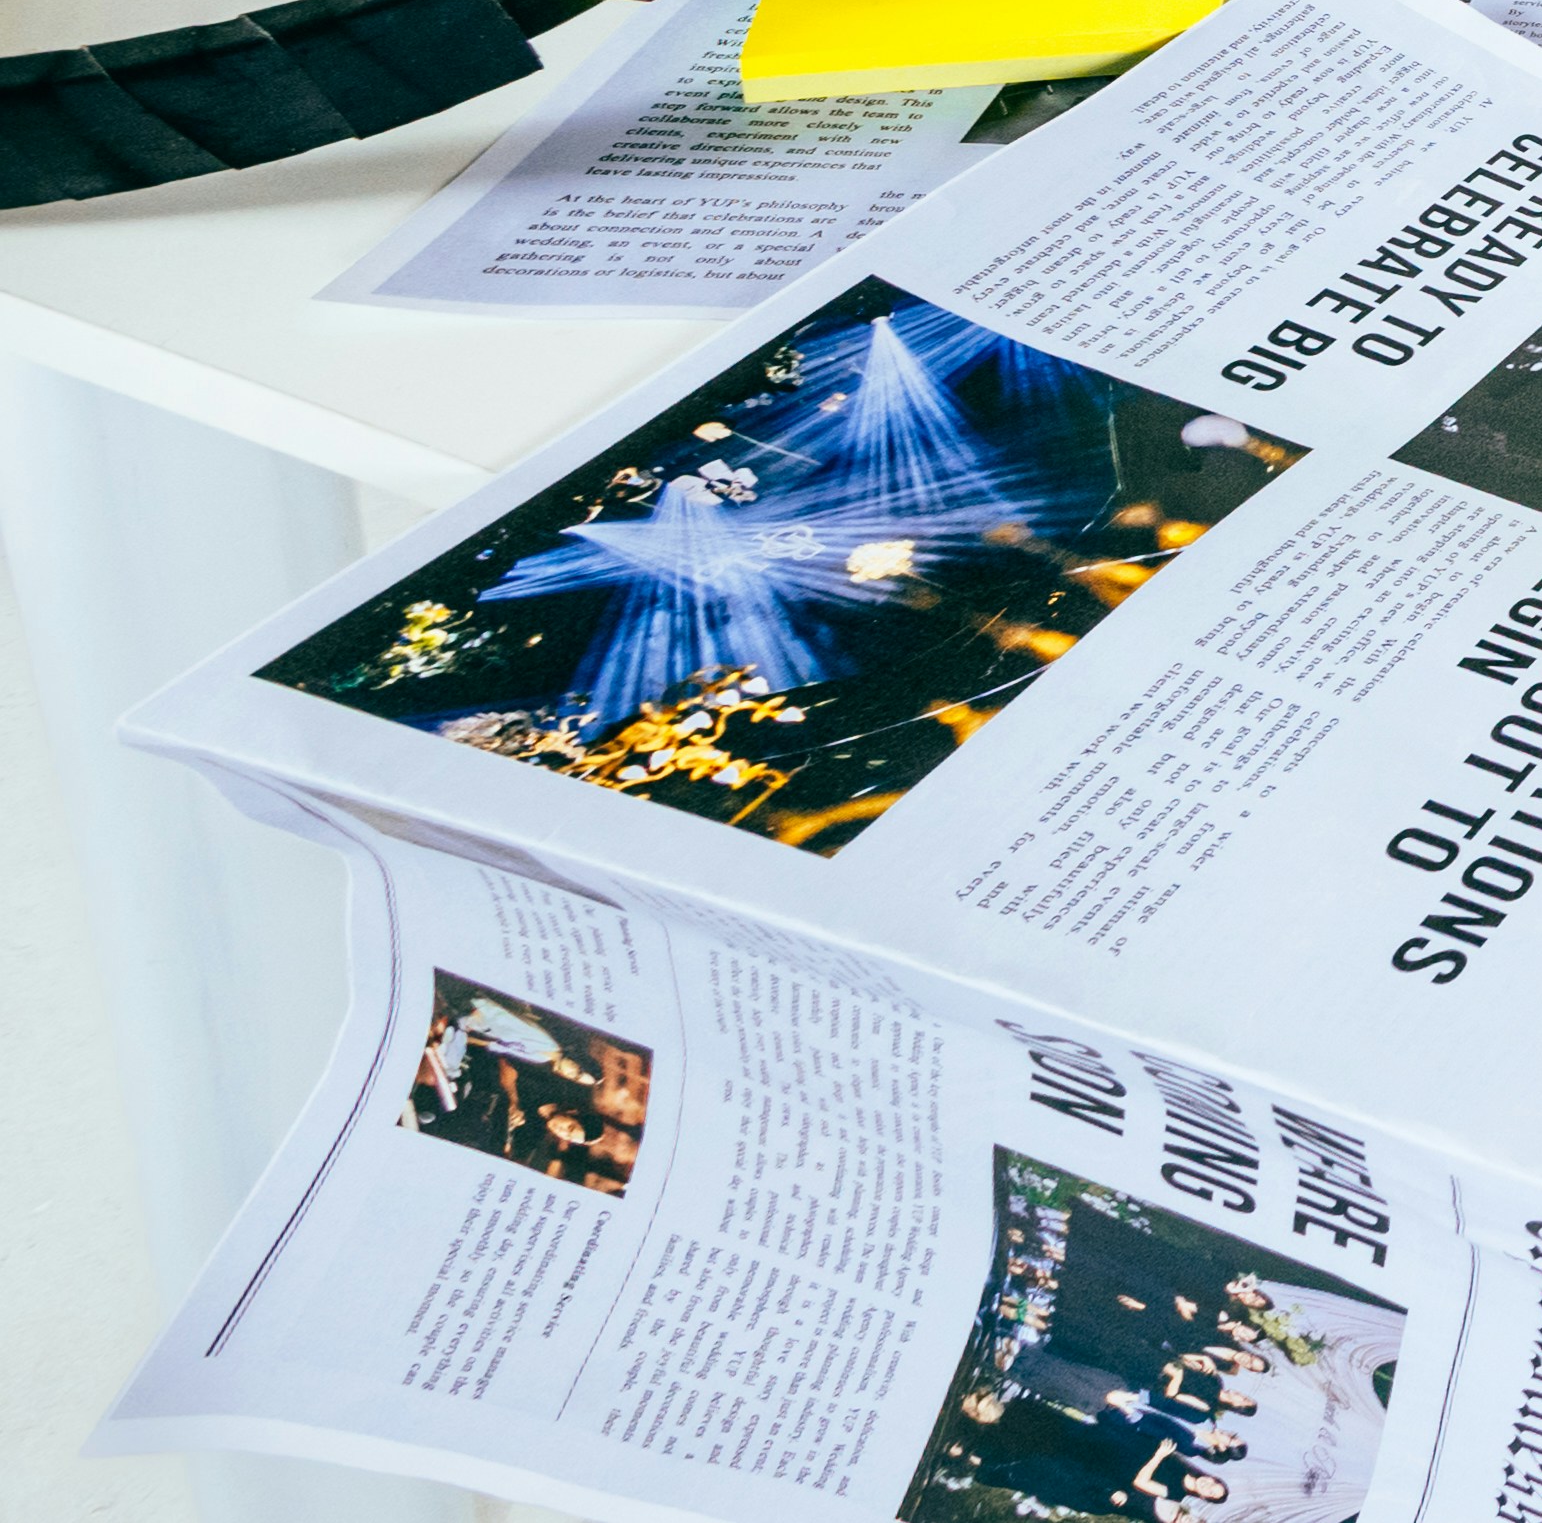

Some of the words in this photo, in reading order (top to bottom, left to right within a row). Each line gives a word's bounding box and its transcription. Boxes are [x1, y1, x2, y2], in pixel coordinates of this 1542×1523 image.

[1228, 33, 1250, 51] and
[1180, 48, 1230, 83] attention
[1379, 52, 1406, 73] more
[1388, 60, 1423, 85] bigger
[1167, 82, 1183, 92] to
[1321, 84, 1363, 115] creative
[1356, 84, 1390, 105] ideas,
[1131, 91, 1168, 114] detail.
[1325, 106, 1361, 132] bolder
[1237, 126, 1305, 173] possibilities.
[1274, 131, 1325, 165] concepts,
[1252, 167, 1275, 184] and
[1220, 195, 1260, 225] people
[1301, 226, 1327, 243] Our
[1150, 237, 1205, 274] together,
[1274, 243, 1300, 264] goal
[1244, 275, 1261, 286] to
[1259, 264, 1276, 273] is
[1108, 289, 1134, 309] and
[1206, 287, 1243, 315] create
[1061, 322, 1092, 342] turn
[1134, 317, 1205, 368] experiences
[1221, 320, 1336, 392] BIG
[1351, 326, 1444, 367] TO
[1457, 513, 1503, 549] opening
[1524, 525, 1538, 534] A
[1503, 534, 1527, 555] new
[1444, 551, 1460, 566] of
[1482, 555, 1503, 572] era
[1405, 567, 1448, 599] YUP's
[1468, 573, 1484, 589] of
[1379, 602, 1405, 624] new
[1423, 587, 1470, 630] creative
[1335, 628, 1377, 666] office,
[1352, 632, 1424, 702] celebrations
[1313, 672, 1336, 689] we
[1234, 690, 1264, 715] that
[1200, 727, 1225, 749] are
[1163, 762, 1191, 785] not
[1118, 798, 1153, 831] only
[1386, 799, 1495, 874] TO
[1022, 845, 1110, 923] beautifully
[1129, 1050, 1259, 1214] COMING
[562, 1210, 612, 1290] Coordinating
[542, 1292, 573, 1339] Service
